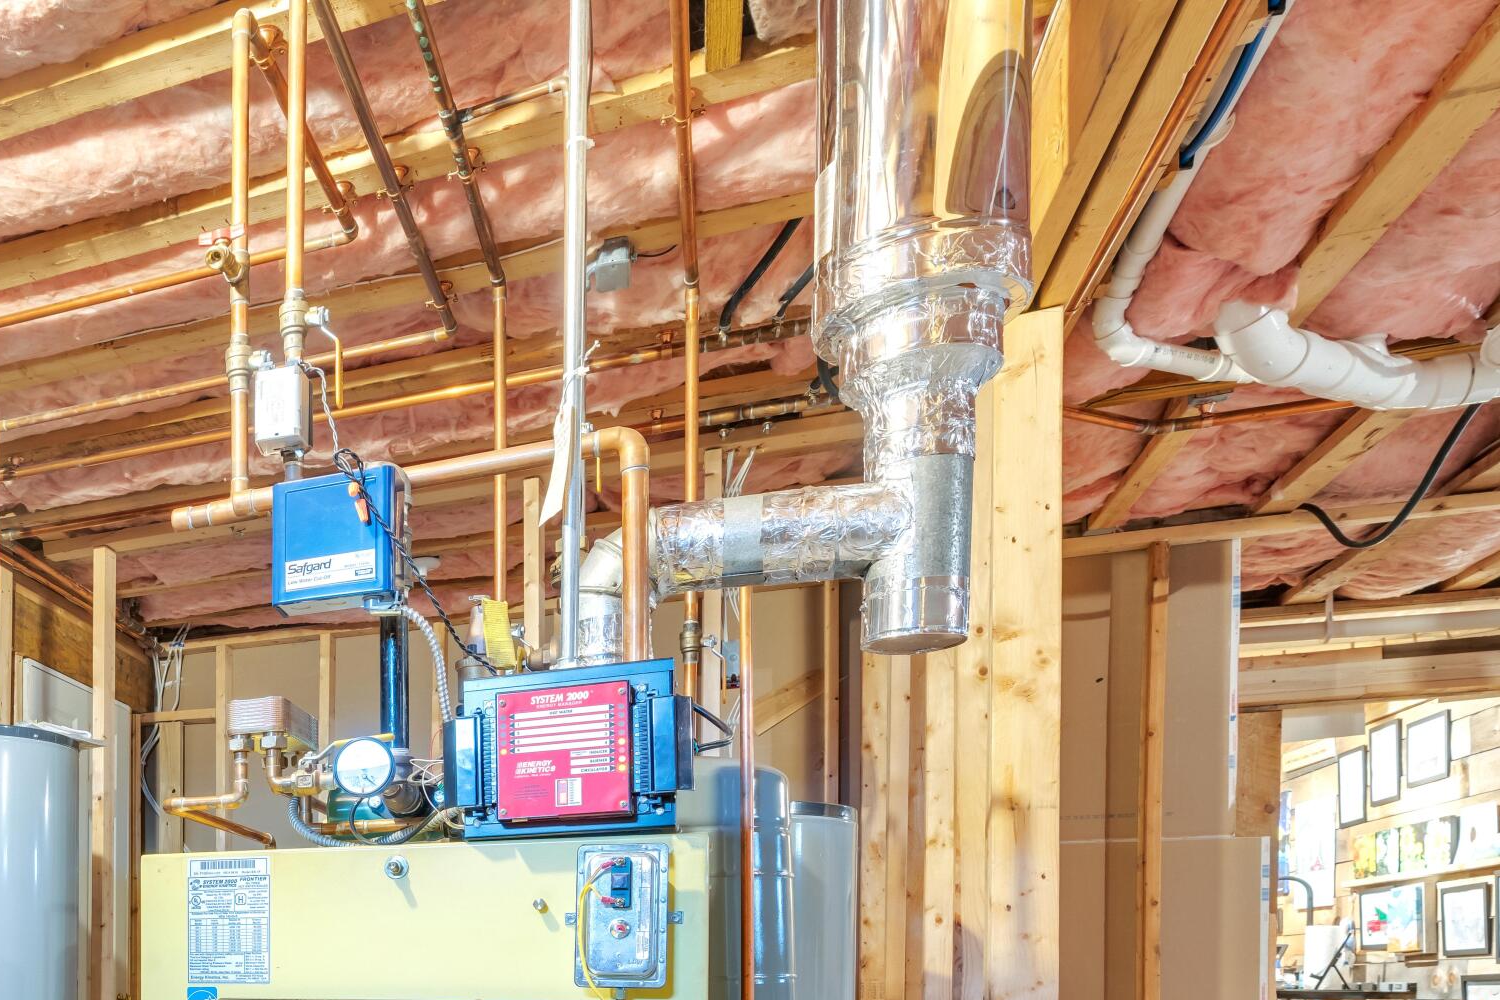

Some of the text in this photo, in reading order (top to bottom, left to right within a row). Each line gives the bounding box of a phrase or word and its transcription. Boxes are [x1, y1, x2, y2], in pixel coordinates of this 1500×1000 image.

[287, 557, 332, 576] Safgard
[530, 690, 589, 705] SYSTEM 2000
[520, 765, 556, 774] KINETICS
[522, 760, 553, 768] ENERGY
